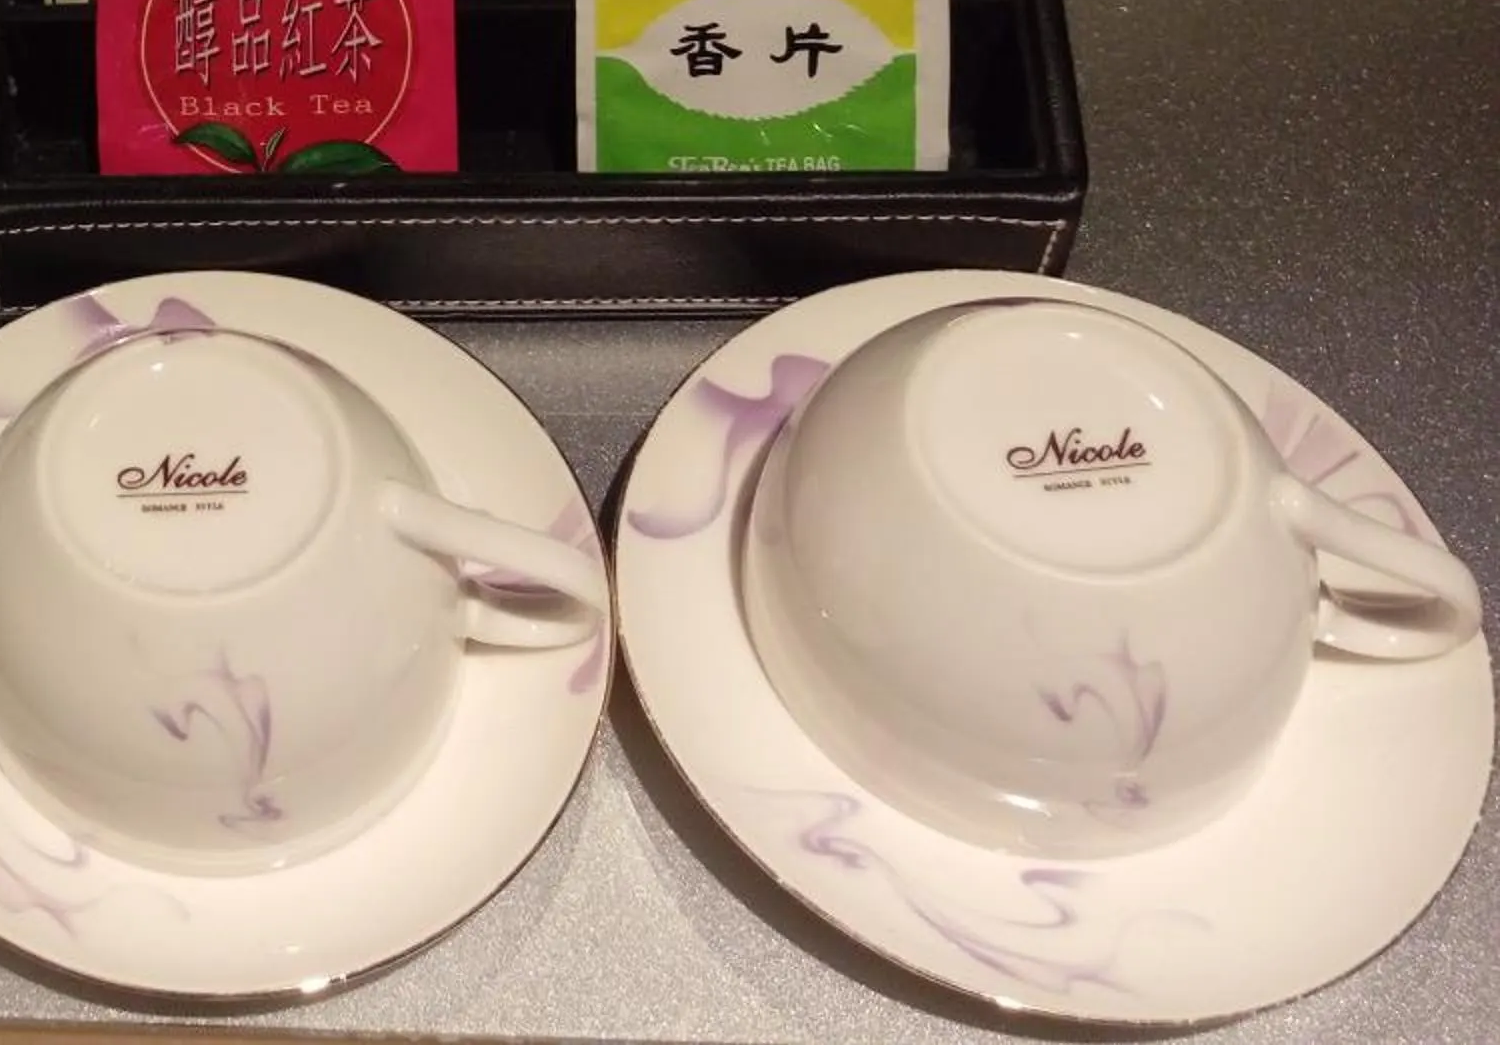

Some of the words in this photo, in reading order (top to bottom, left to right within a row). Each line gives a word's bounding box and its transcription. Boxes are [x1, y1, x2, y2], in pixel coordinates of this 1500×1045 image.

[669, 22, 844, 78] 香片
[179, 95, 286, 118] Black
[309, 93, 373, 115] Tea
[765, 157, 798, 172] TEA
[802, 155, 842, 172] BAG
[1005, 426, 1147, 471] Nicole
[116, 453, 248, 490] Nicole
